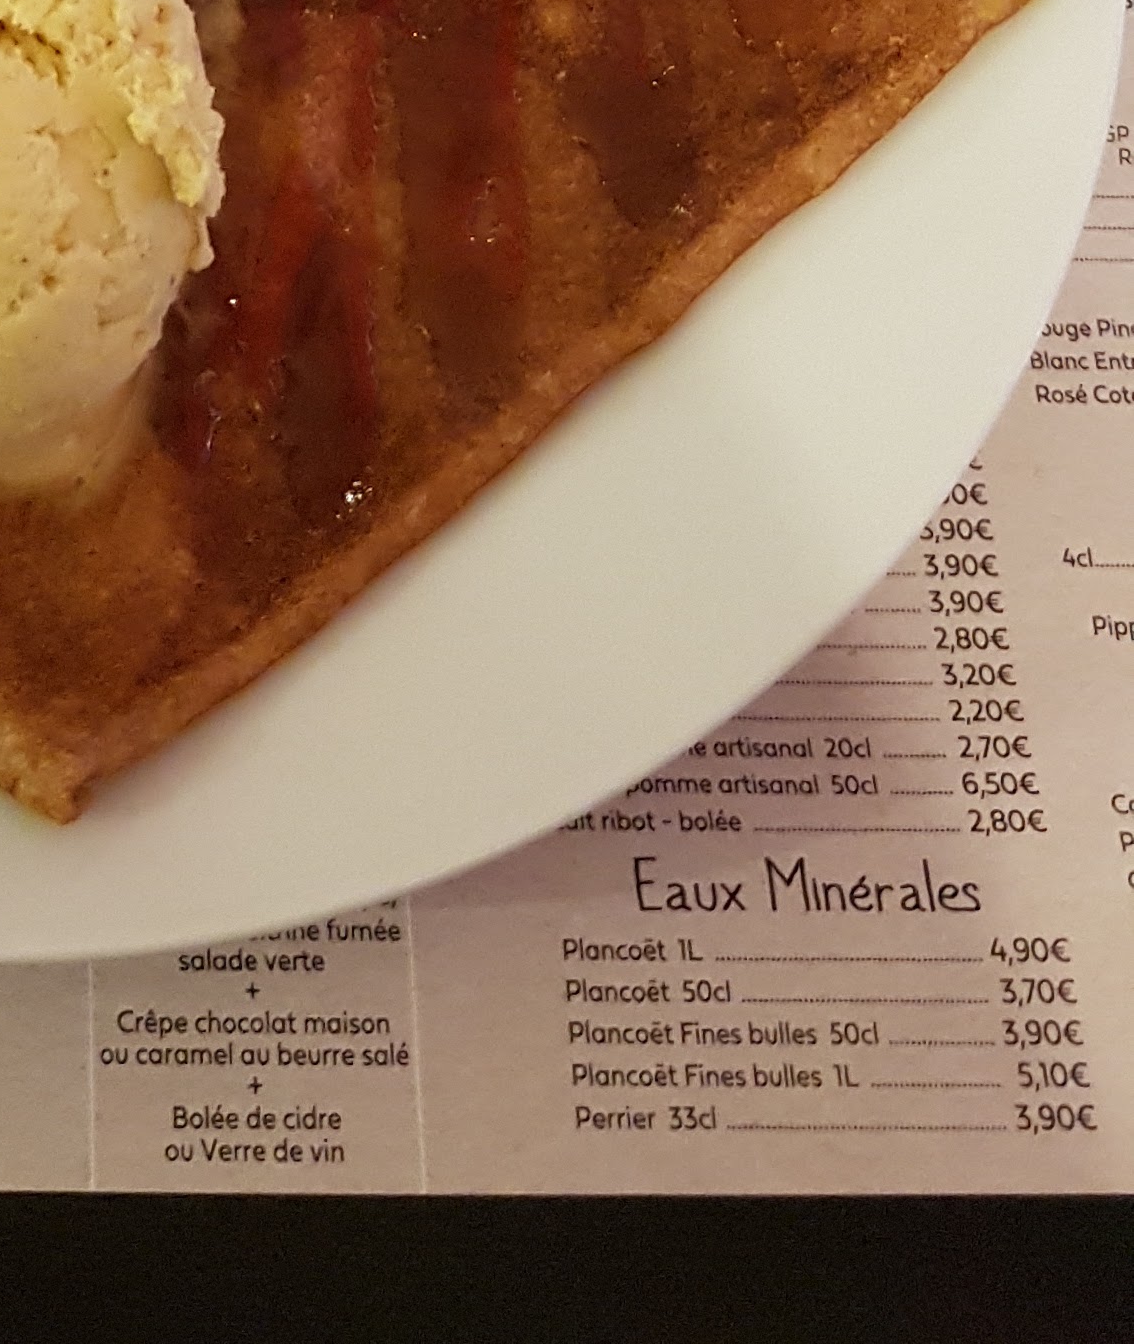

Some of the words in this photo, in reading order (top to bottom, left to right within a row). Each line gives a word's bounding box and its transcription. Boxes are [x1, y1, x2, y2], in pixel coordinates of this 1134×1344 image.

[633, 856, 747, 913] Eaux
[764, 856, 982, 913] Minérales
[562, 937, 668, 963] Plancoët
[677, 938, 704, 962] 1L
[990, 936, 1071, 967] 4,90€
[565, 978, 671, 1004] Plancoët
[682, 979, 731, 1004] 50cl
[999, 977, 1078, 1008] 3,70€
[116, 1008, 189, 1041] Crêpe
[194, 1009, 298, 1035] chocolat
[303, 1010, 391, 1037] maison
[568, 1019, 675, 1046] Plancoët
[679, 1021, 743, 1046] Fines
[747, 1020, 818, 1046] bulles
[829, 1021, 880, 1046] 50cl
[1001, 1018, 1085, 1051] 3,90€
[98, 1047, 129, 1066] ou
[134, 1041, 234, 1066] caramel
[239, 1047, 271, 1067] au
[276, 1041, 356, 1067] beurre
[361, 1041, 410, 1068] salé
[571, 1062, 679, 1088] Plancoët
[684, 1063, 747, 1089] Fines
[752, 1062, 823, 1089] bulles
[832, 1063, 860, 1088] 1L
[1017, 1061, 1091, 1093] 5,10€
[172, 1104, 240, 1130] Bolée
[245, 1105, 277, 1131] de
[282, 1105, 342, 1131] cidre
[574, 1105, 657, 1131] Perrier
[668, 1105, 718, 1131] 33cl
[1014, 1103, 1098, 1136] 3,90€
[164, 1143, 195, 1163] ou
[200, 1138, 267, 1163] Verre
[272, 1137, 304, 1164] de
[309, 1137, 345, 1164] vin
